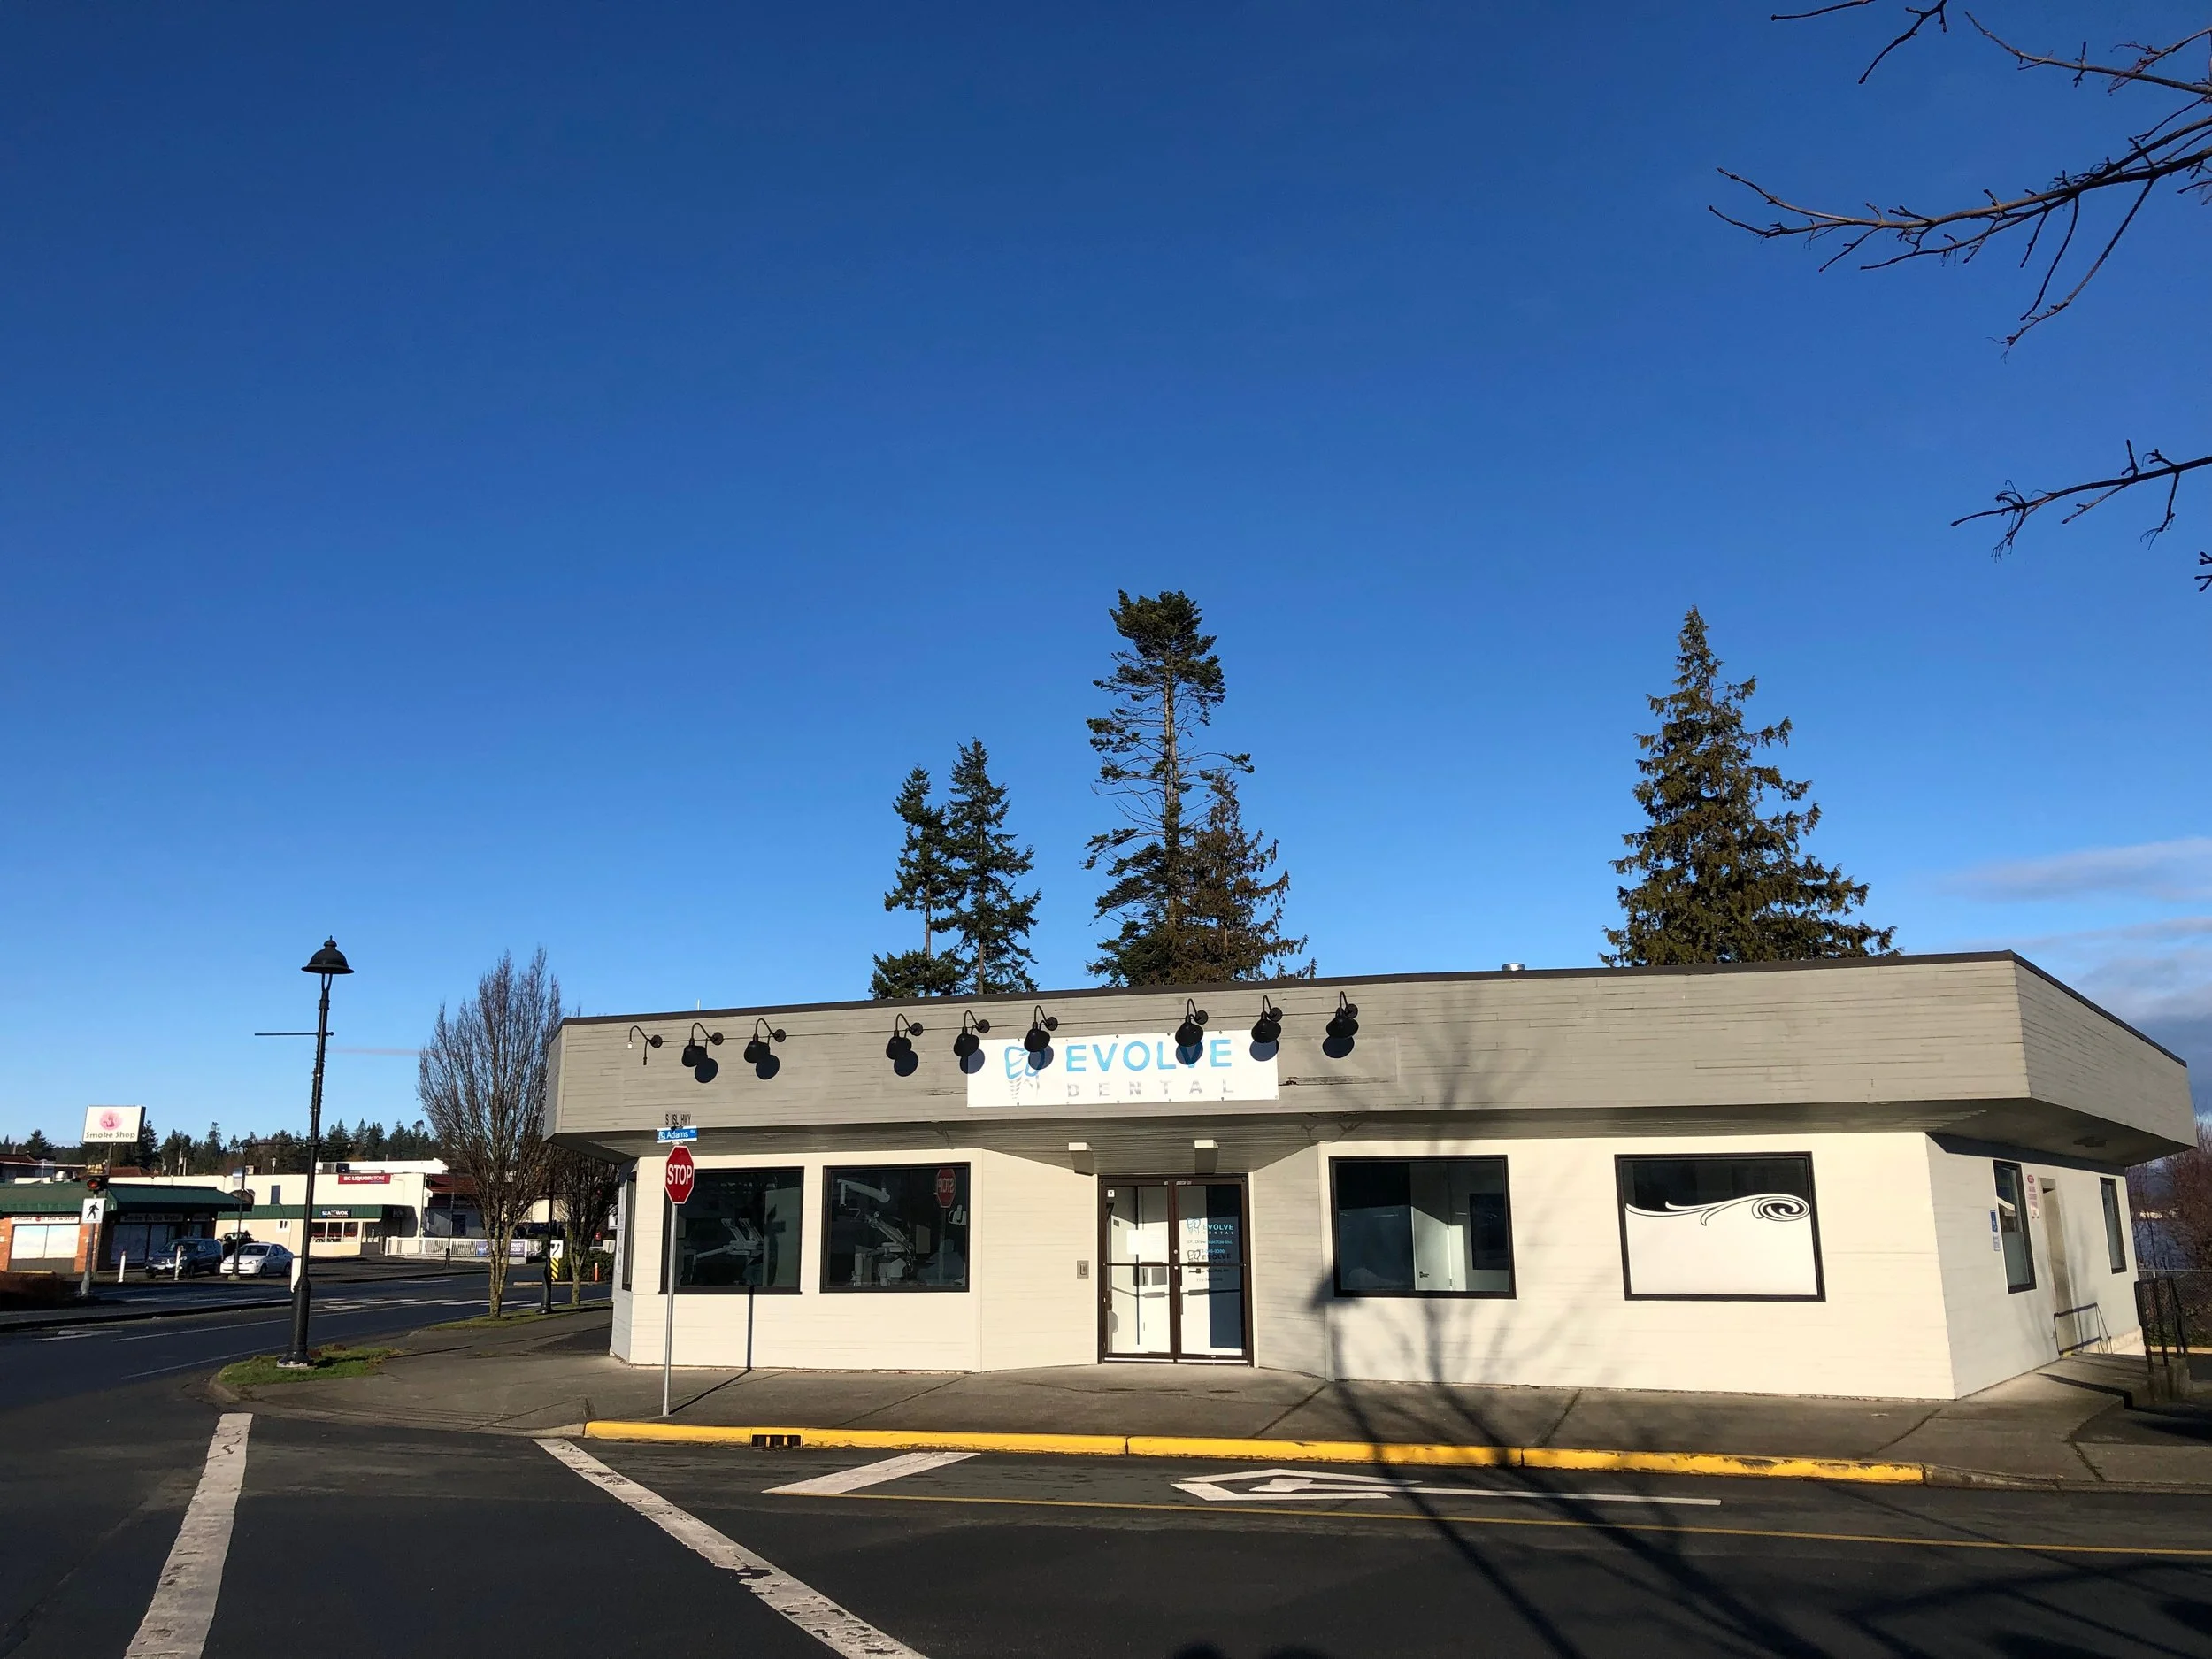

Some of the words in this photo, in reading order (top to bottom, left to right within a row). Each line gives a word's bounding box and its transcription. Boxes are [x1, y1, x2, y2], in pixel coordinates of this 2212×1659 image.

[1065, 1039, 1233, 1072] EVOLVE
[1067, 1079, 1234, 1098] DENTAL
[667, 1130, 689, 1139] Adams
[666, 1164, 693, 1185] STOP
